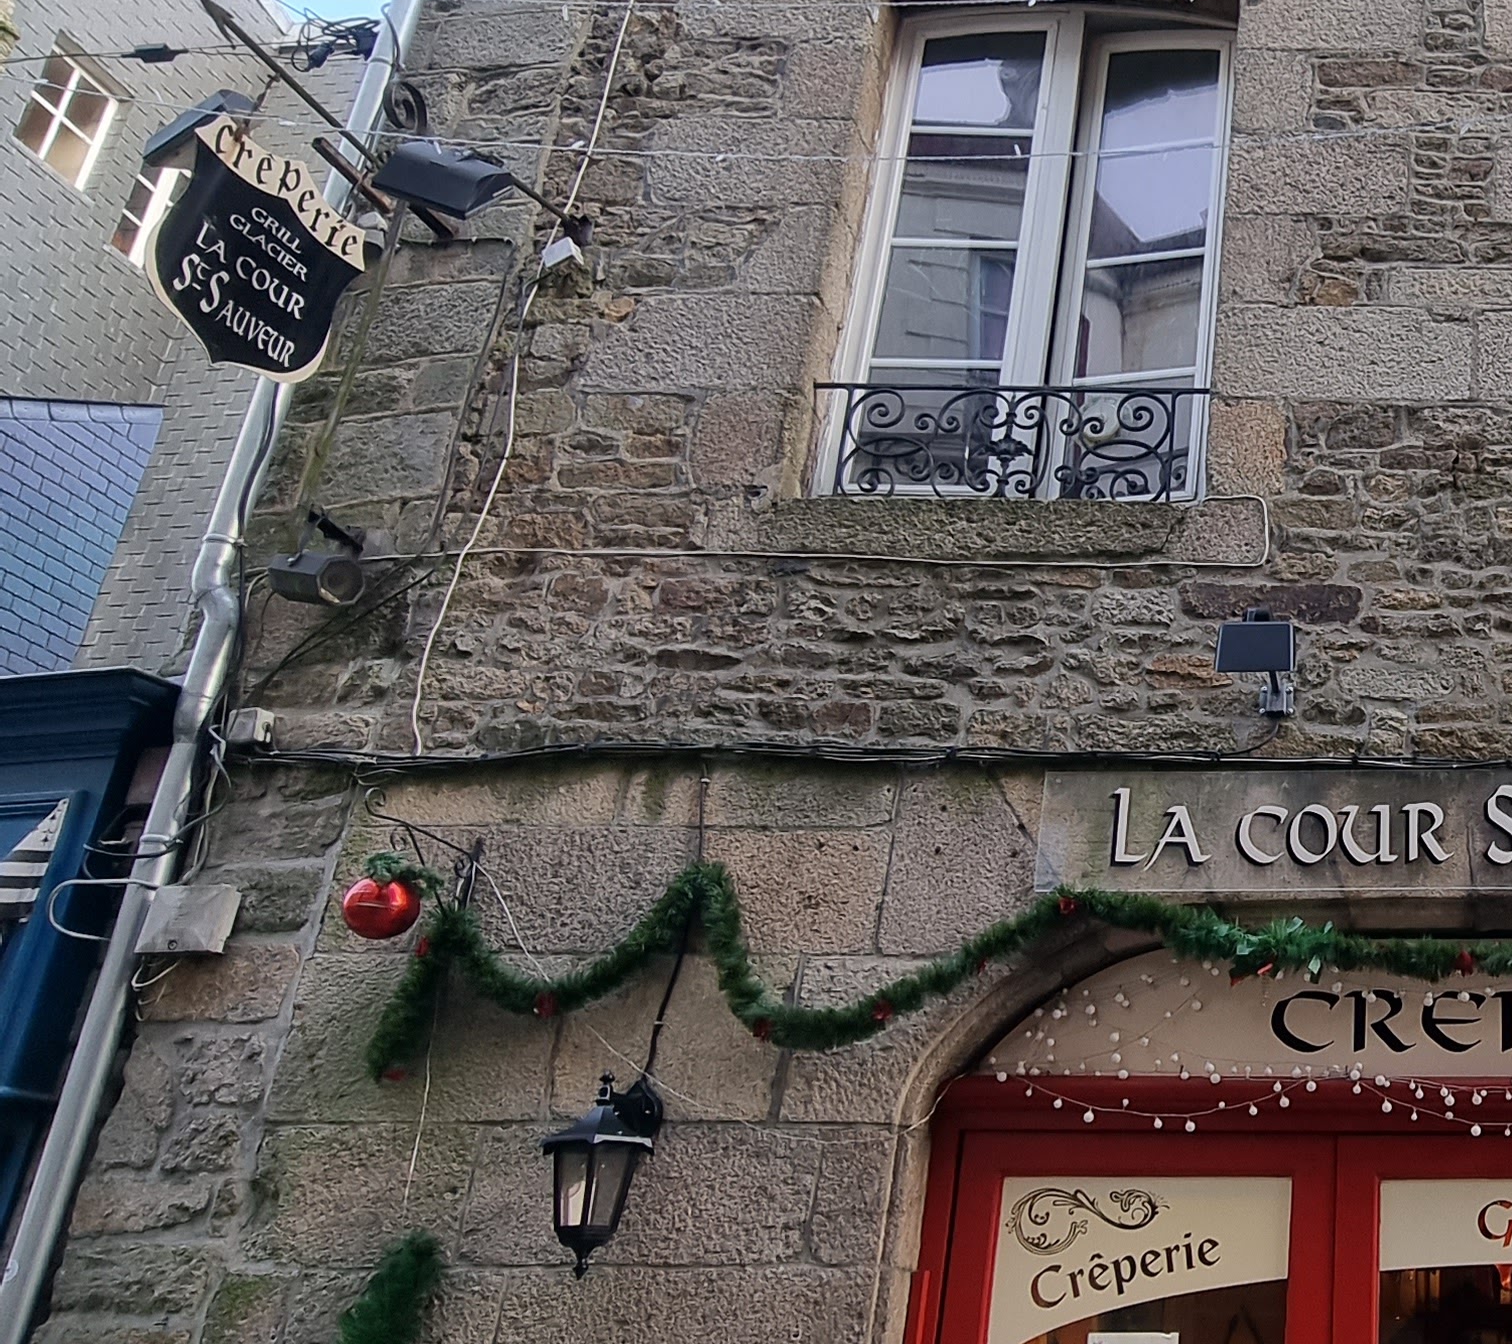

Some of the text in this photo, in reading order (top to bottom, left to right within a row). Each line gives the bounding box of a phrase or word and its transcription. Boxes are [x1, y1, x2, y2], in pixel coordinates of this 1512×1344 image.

[229, 214, 309, 282] GLACIER
[251, 207, 303, 254] GRILL
[195, 221, 305, 320] LA COUR
[1029, 1231, 1222, 1309] Crêperie
